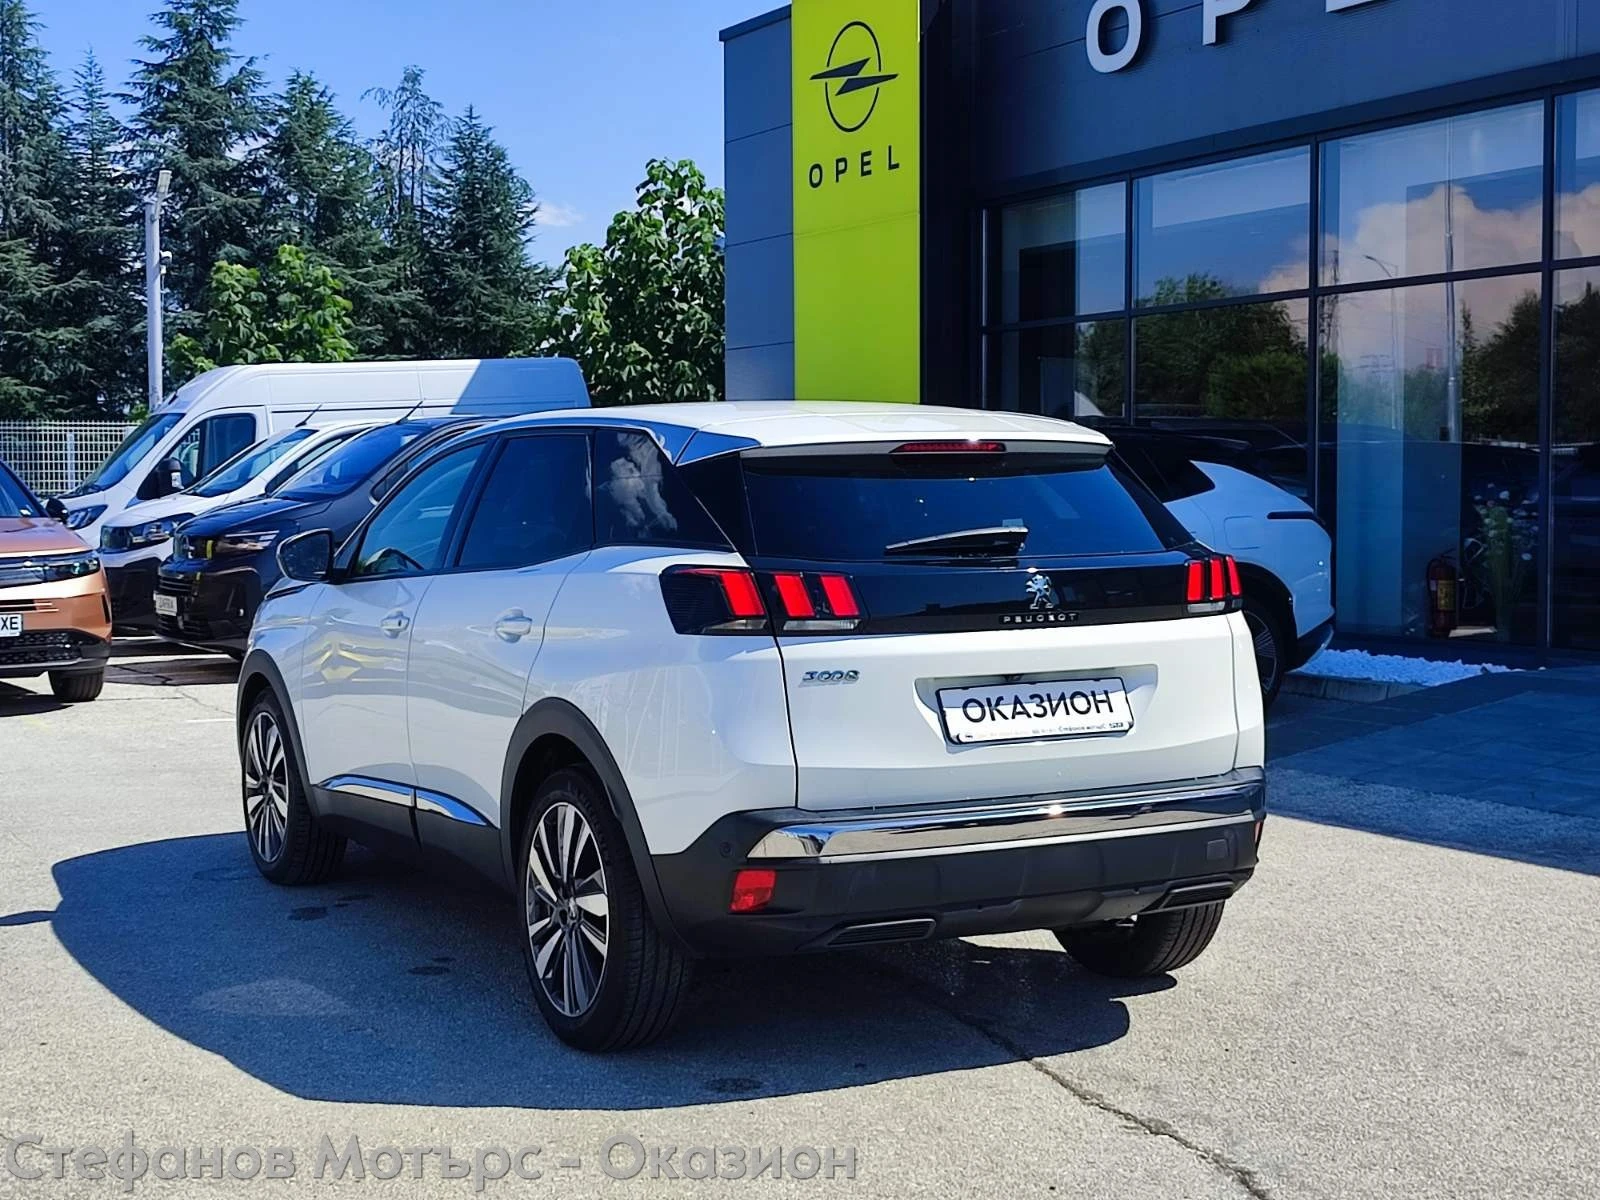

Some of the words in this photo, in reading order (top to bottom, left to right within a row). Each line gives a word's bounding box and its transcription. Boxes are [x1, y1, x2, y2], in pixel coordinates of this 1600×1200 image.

[808, 144, 900, 189] OPEL
[1003, 613, 1077, 623] PEUGEOT
[802, 669, 860, 682] 3008
[962, 690, 1114, 723] ОКАЗИОН
